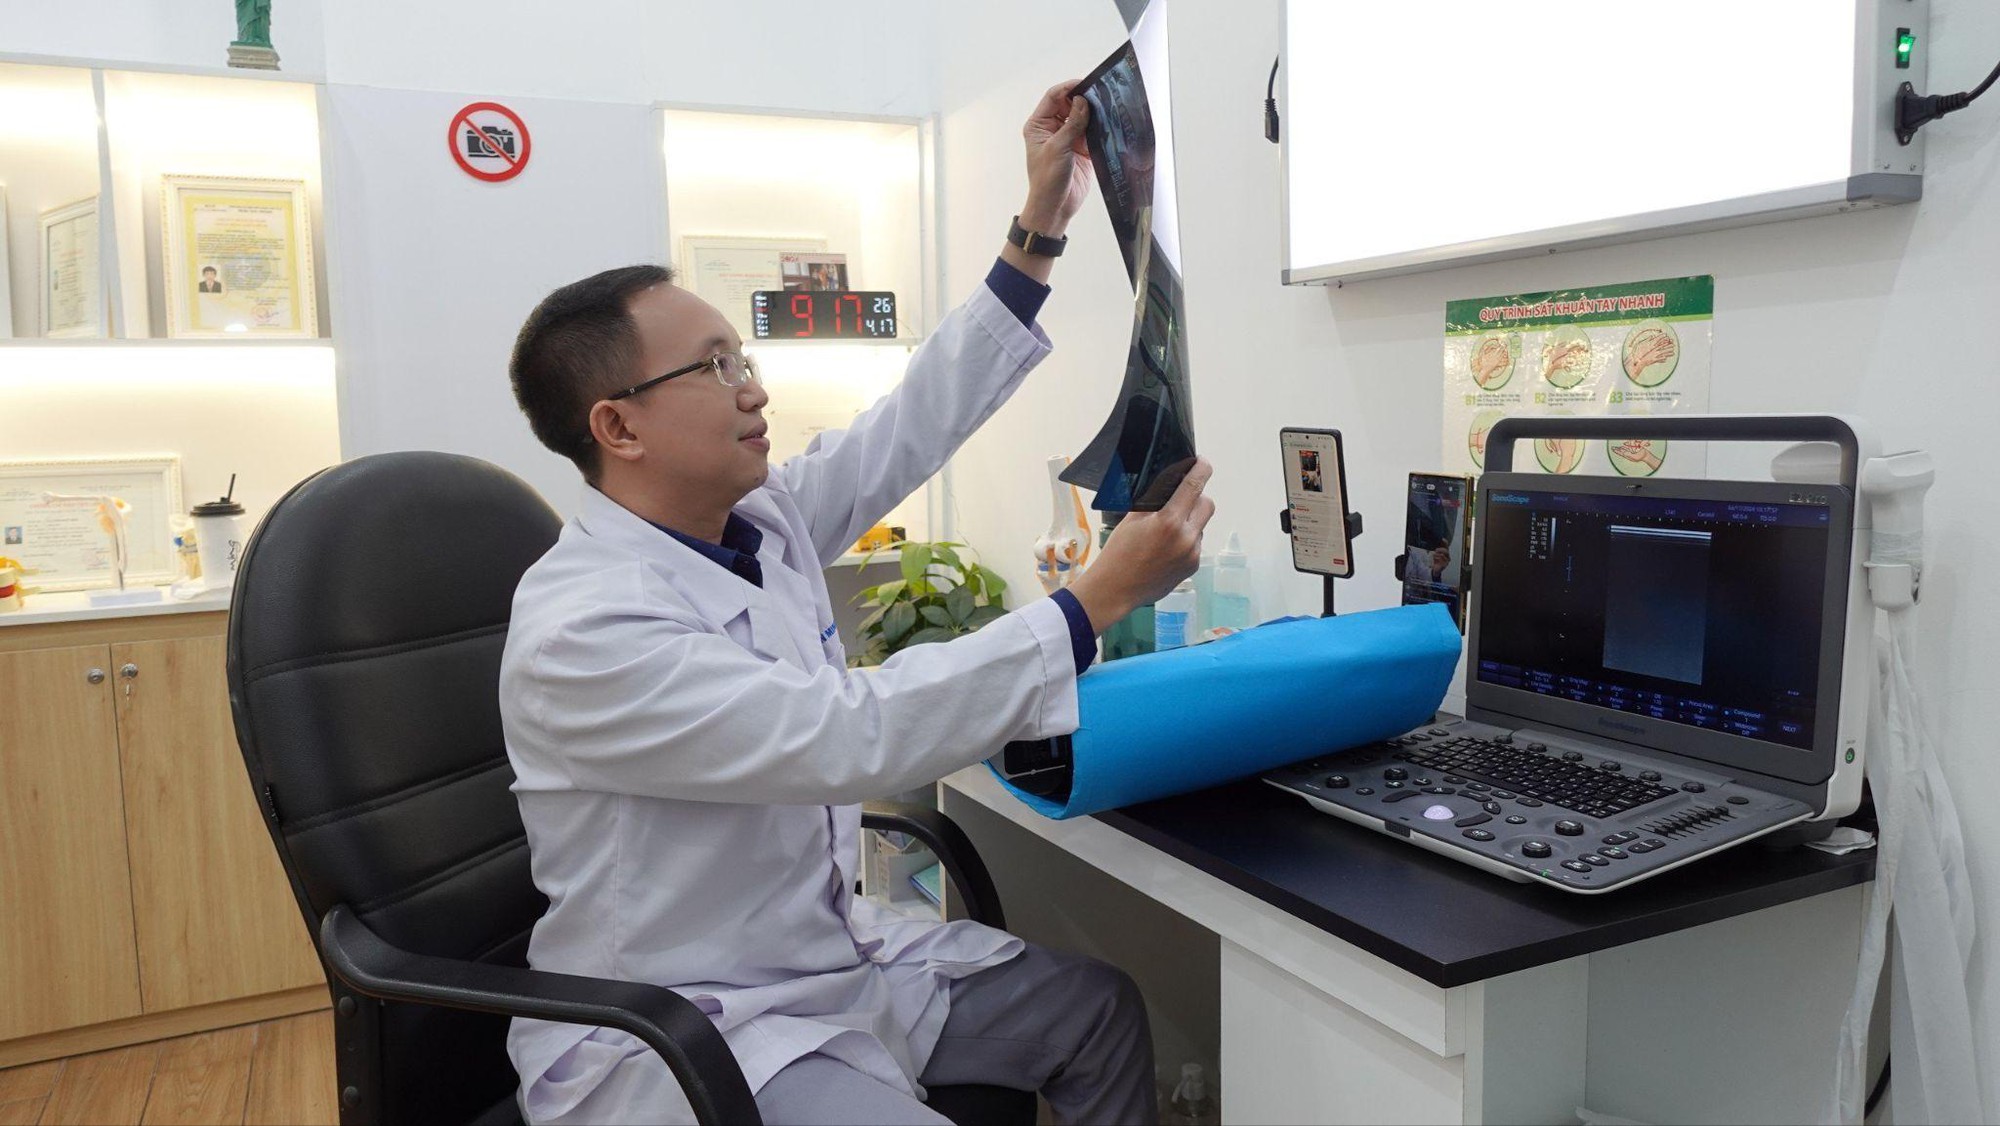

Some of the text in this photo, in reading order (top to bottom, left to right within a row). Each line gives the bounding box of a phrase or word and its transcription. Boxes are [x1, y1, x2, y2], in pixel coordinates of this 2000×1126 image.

[791, 294, 862, 337] 9 17
[1480, 306, 1501, 322] QUY
[1595, 297, 1618, 313] TAY
[1618, 293, 1665, 311] NHANH
[1535, 392, 1546, 403] B2
